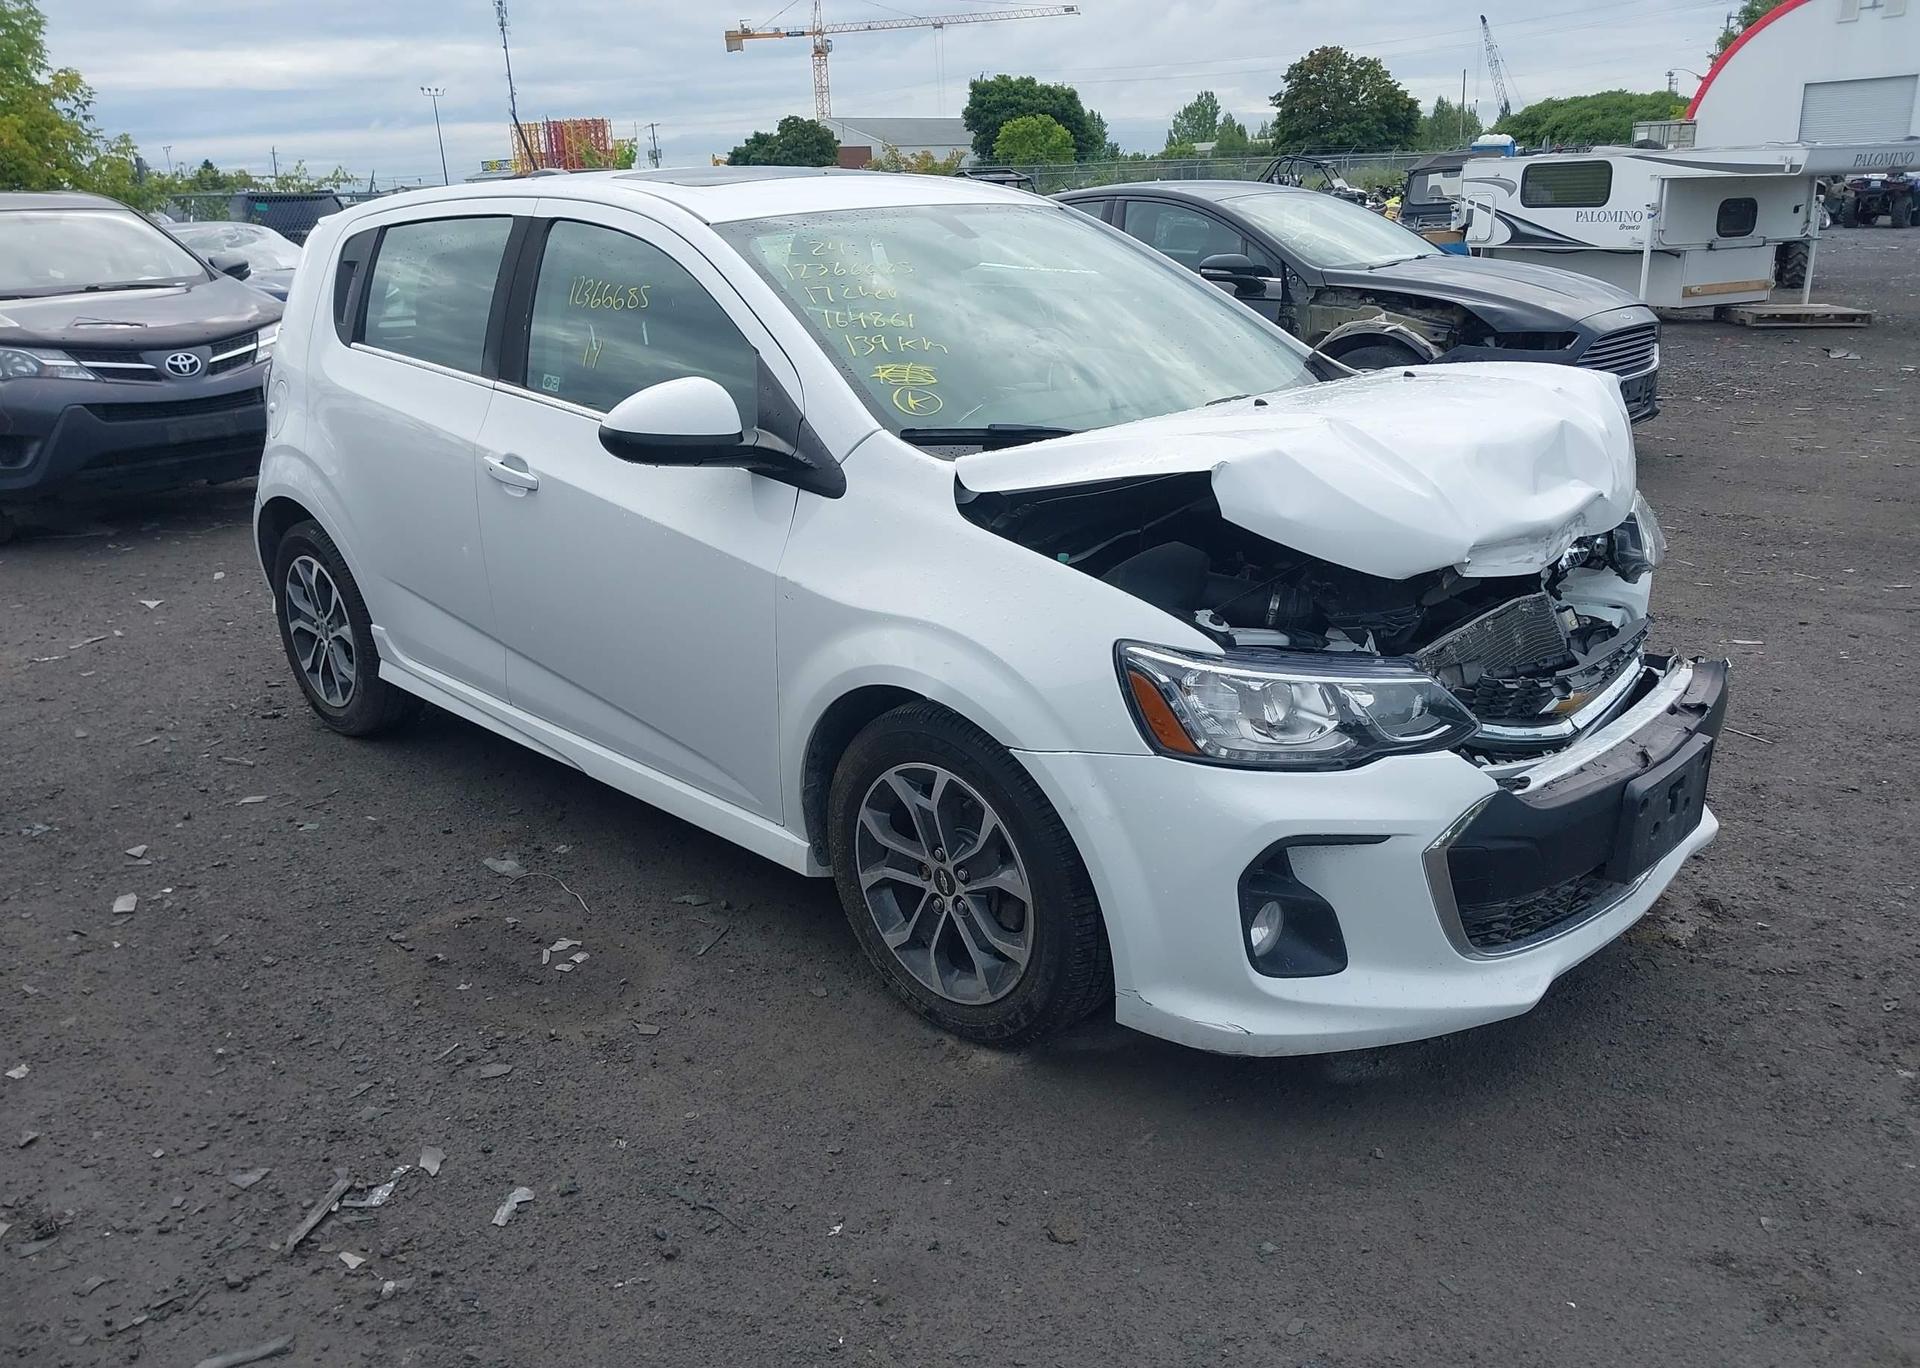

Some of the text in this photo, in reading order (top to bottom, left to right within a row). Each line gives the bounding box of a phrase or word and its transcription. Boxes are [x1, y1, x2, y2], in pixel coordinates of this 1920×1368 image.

[1853, 151, 1915, 167] PALOMINO
[1575, 210, 1643, 222] PALOMINO
[1618, 223, 1640, 231] Bronco
[845, 334, 893, 357] 139
